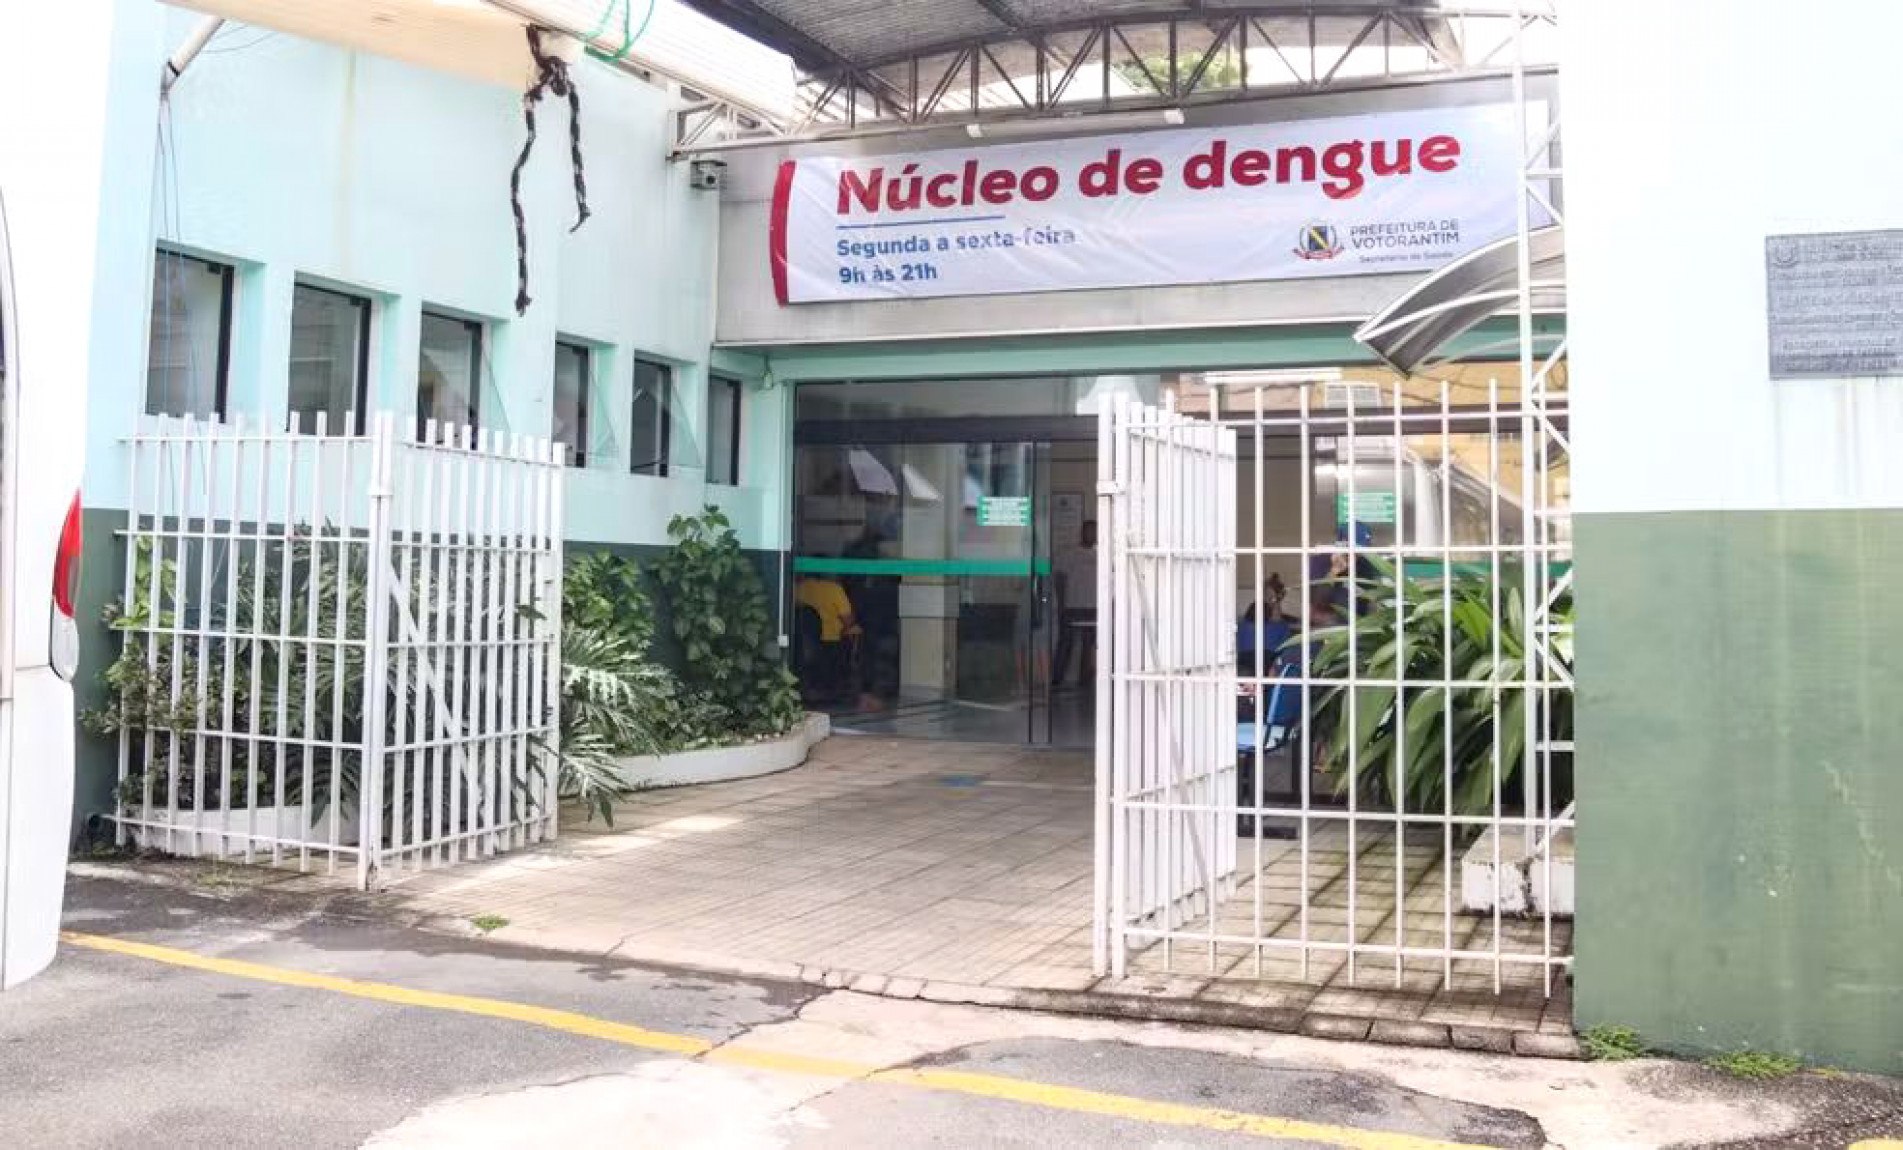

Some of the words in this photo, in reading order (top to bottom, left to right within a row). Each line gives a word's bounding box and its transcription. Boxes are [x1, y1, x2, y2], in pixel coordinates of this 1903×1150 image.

[837, 159, 1059, 214] Núcleo
[1078, 154, 1162, 196] de
[1183, 135, 1461, 199] dengue
[1350, 222, 1435, 236] PREFEITURA
[1440, 219, 1459, 231] DE
[836, 235, 931, 258] Segunda
[937, 236, 949, 251] a
[956, 225, 1076, 250] sexta-feira
[1351, 231, 1459, 250] VOTORANTIM
[838, 265, 866, 284] 9h
[872, 265, 895, 282] às
[900, 262, 937, 281] 21h
